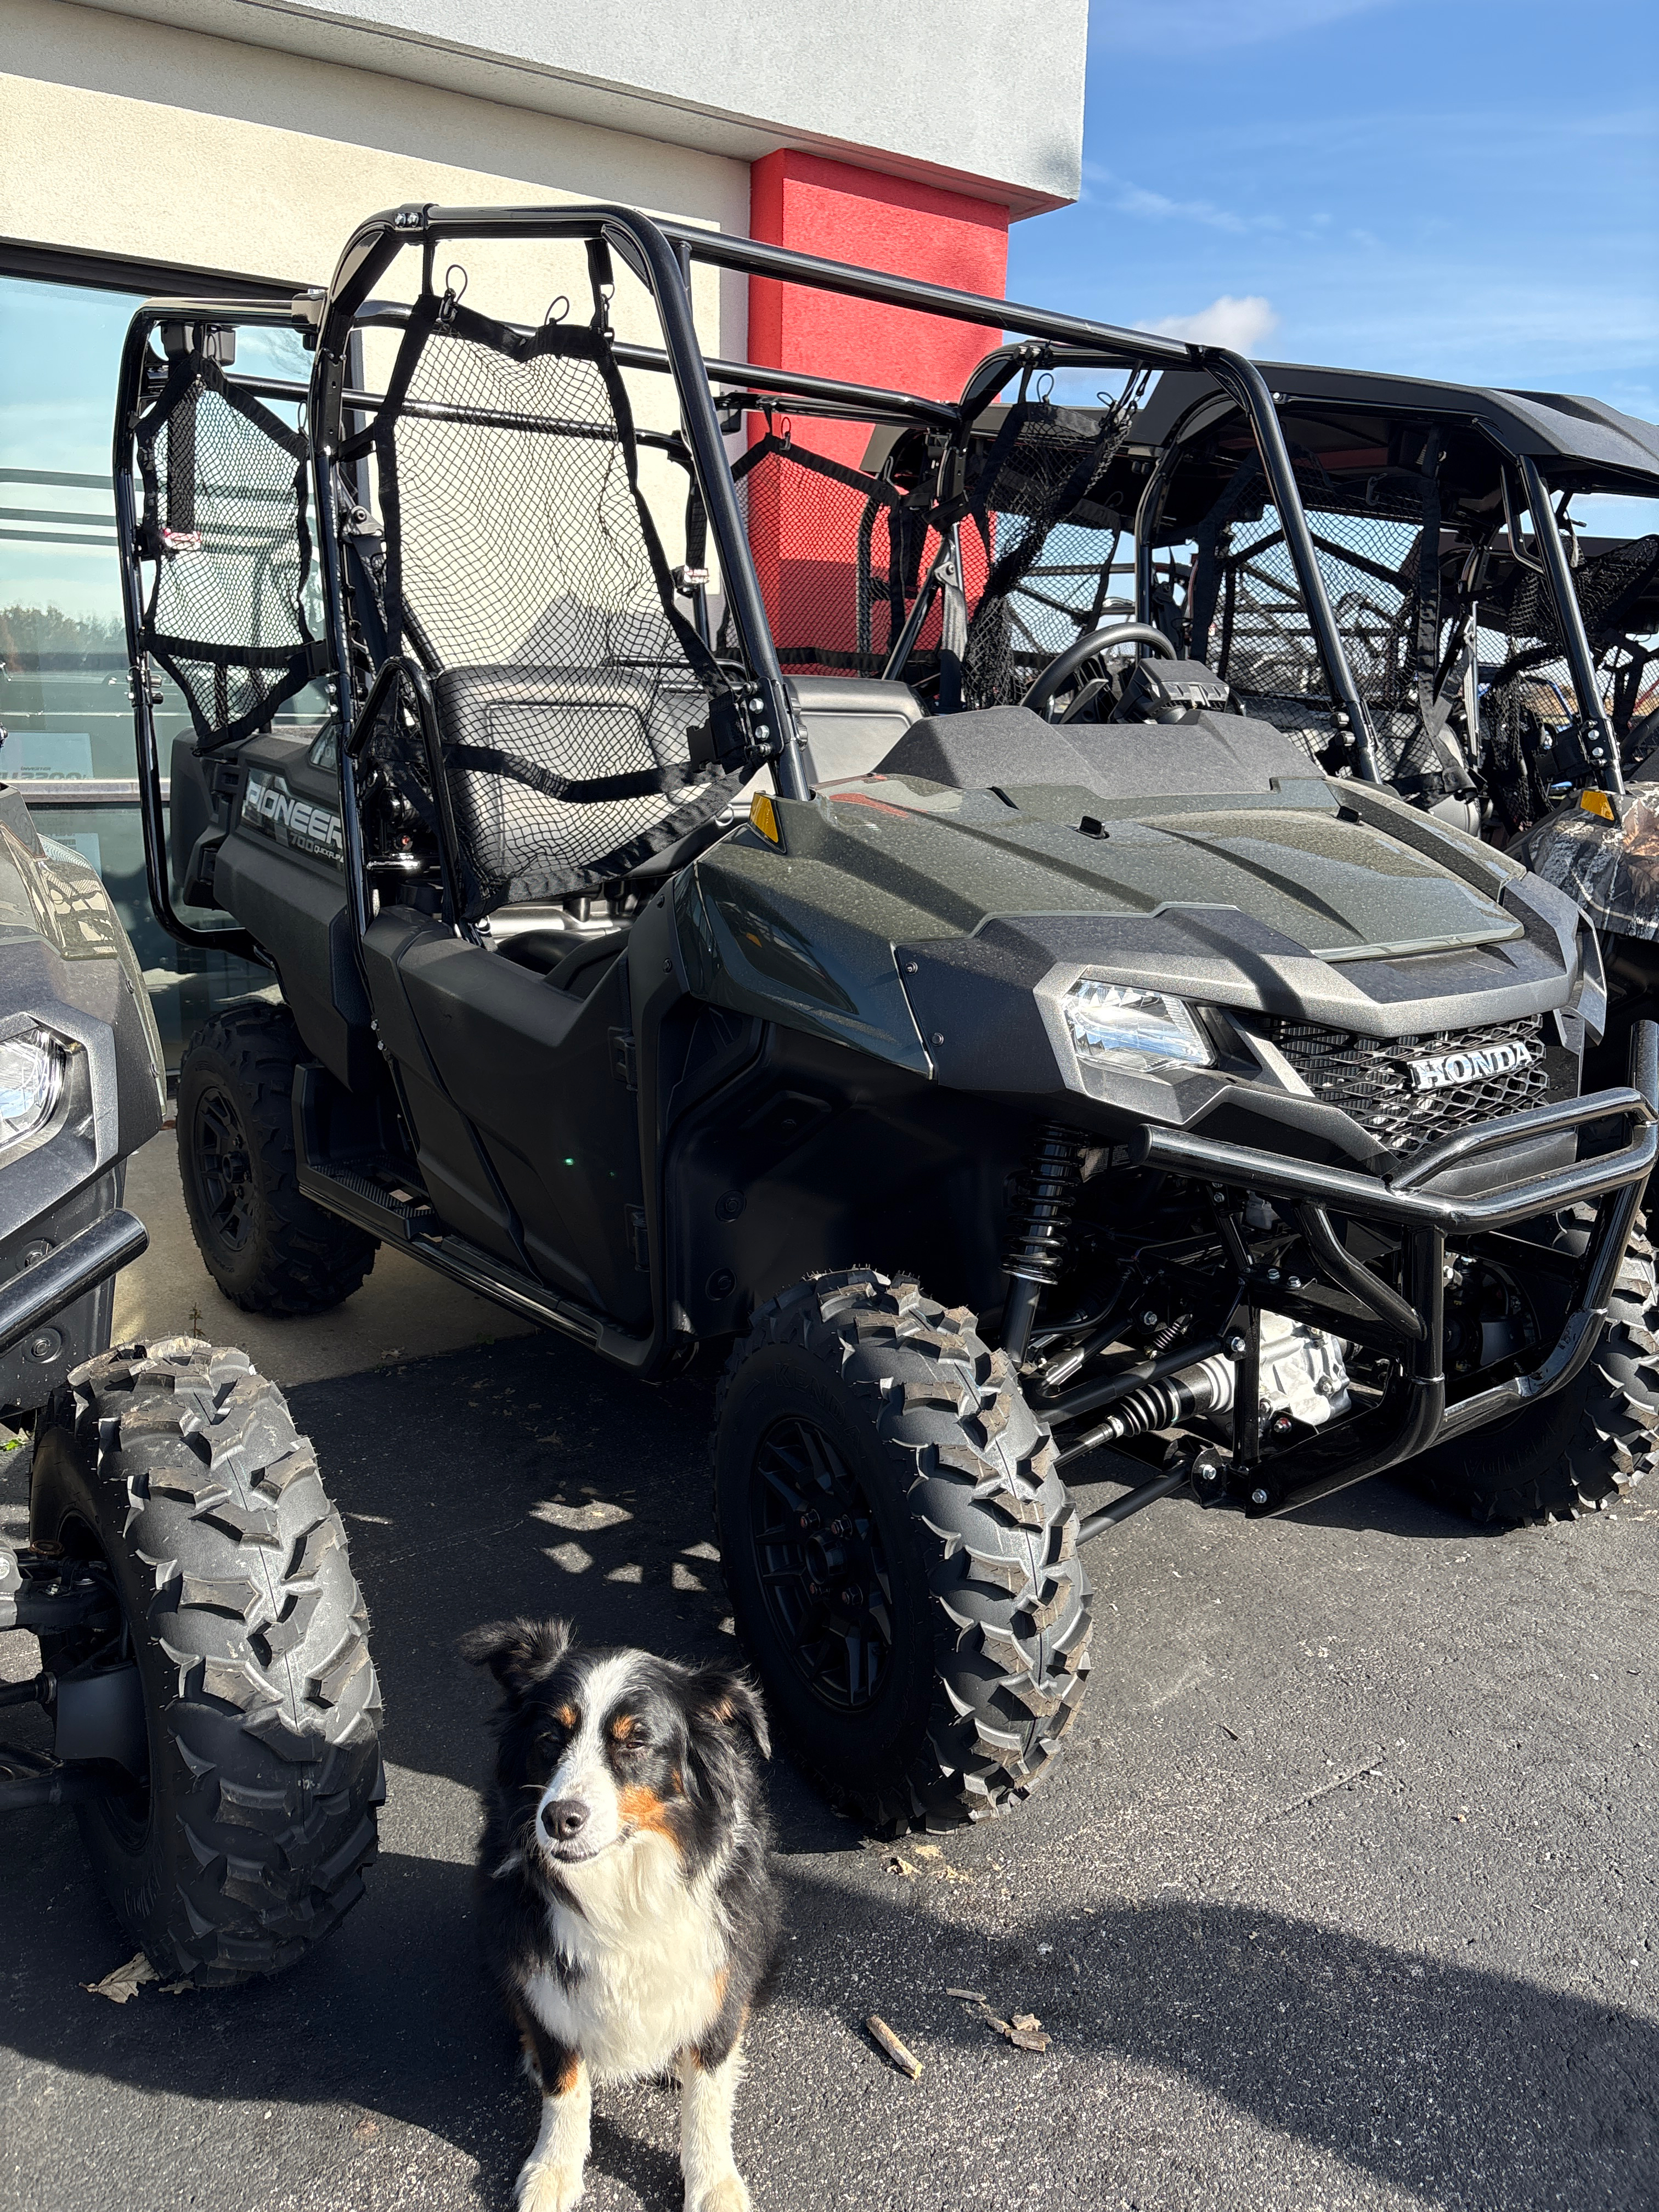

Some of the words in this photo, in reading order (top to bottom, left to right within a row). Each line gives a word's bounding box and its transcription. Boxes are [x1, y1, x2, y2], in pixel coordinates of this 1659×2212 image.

[246, 781, 343, 849] PIONEER
[290, 832, 314, 853] 700
[1409, 1042, 1532, 1090] HONDA
[774, 1363, 862, 1454] KENDA
